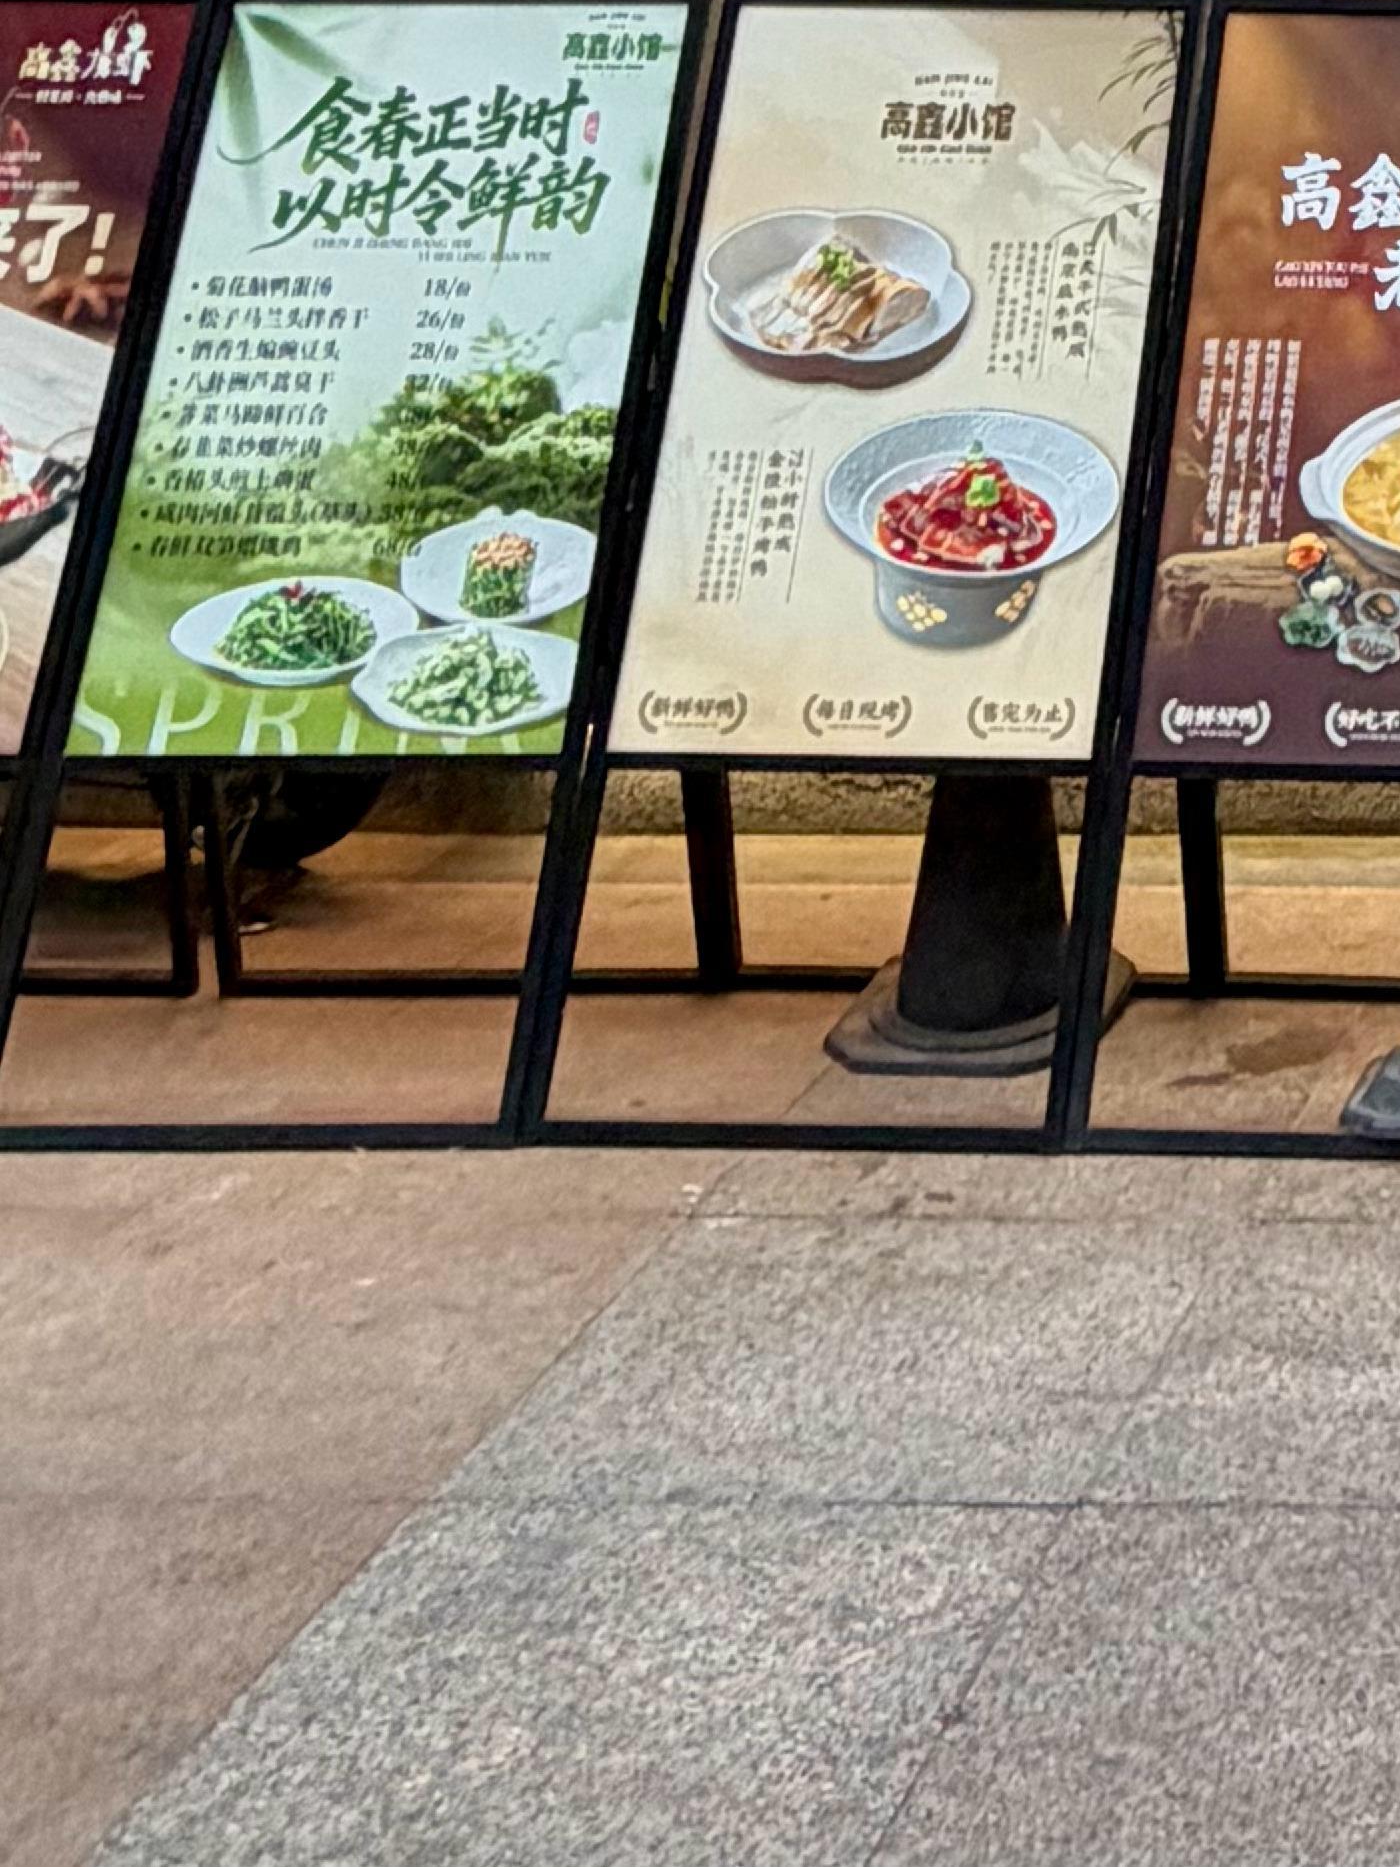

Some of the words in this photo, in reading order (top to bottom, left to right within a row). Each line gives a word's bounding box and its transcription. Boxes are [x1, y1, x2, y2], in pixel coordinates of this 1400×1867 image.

[562, 31, 663, 61] 高鑫小馆
[216, 76, 590, 175] 食春正当时
[880, 100, 1017, 141] 高鑫小馆
[248, 151, 611, 270] 以时令鲜韵
